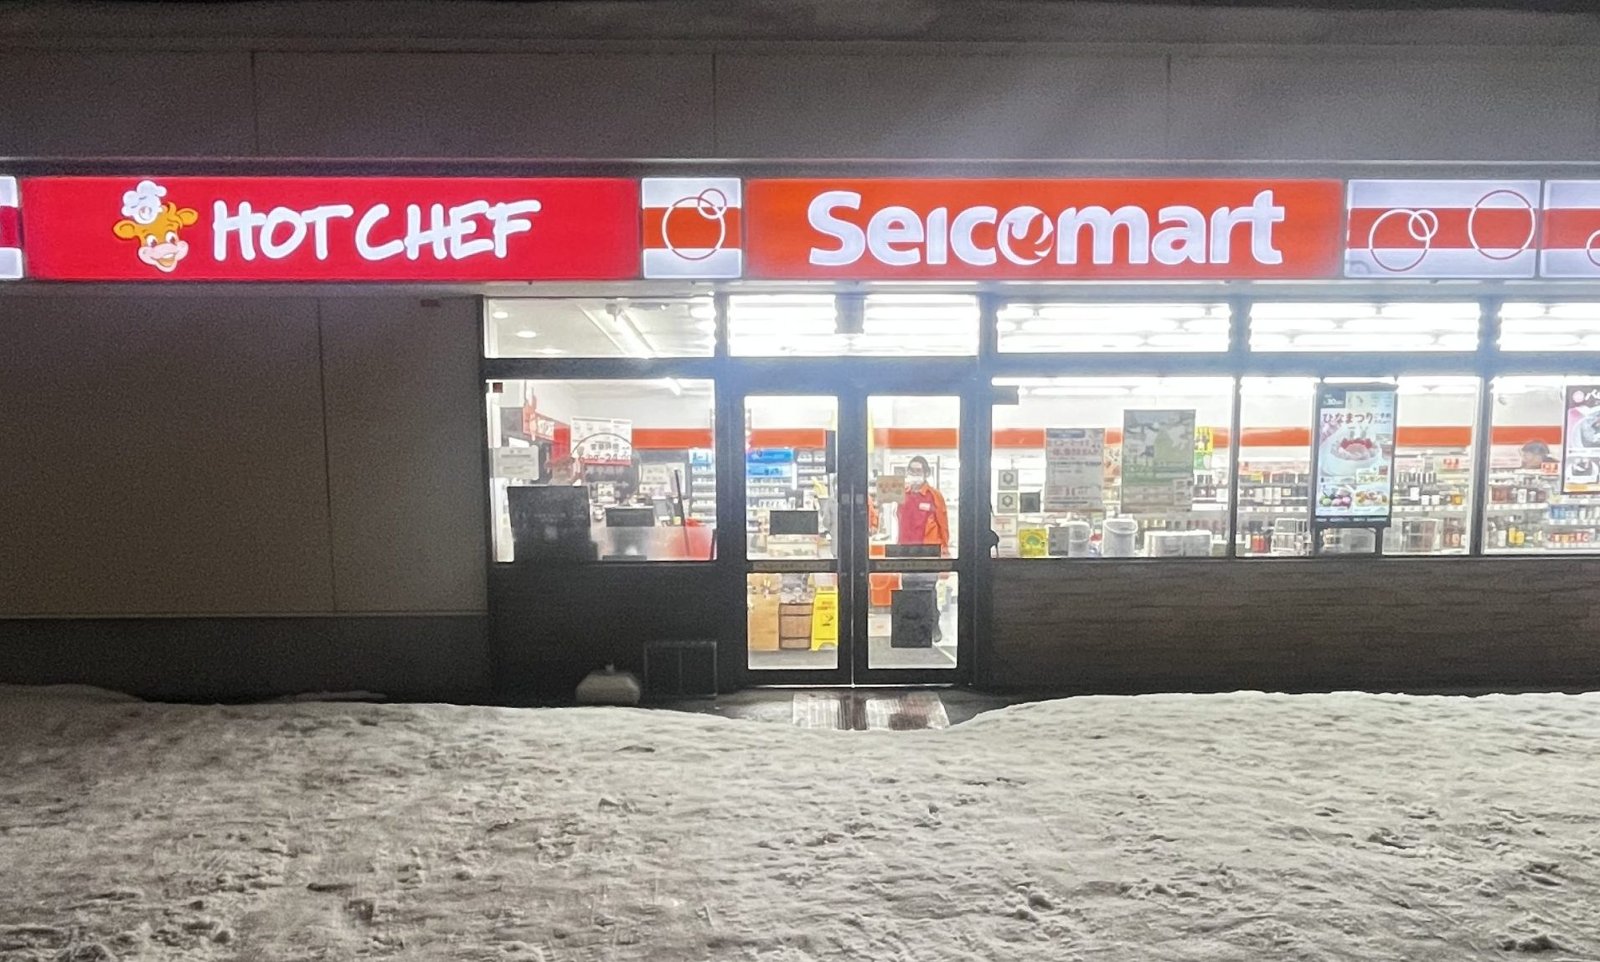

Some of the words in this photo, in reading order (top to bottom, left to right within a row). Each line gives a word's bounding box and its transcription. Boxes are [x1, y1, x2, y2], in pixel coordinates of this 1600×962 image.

[213, 200, 354, 262] HOT
[355, 199, 541, 261] CHEF
[807, 189, 1286, 267] Seicomart
[1322, 412, 1373, 425] ひなまつり
